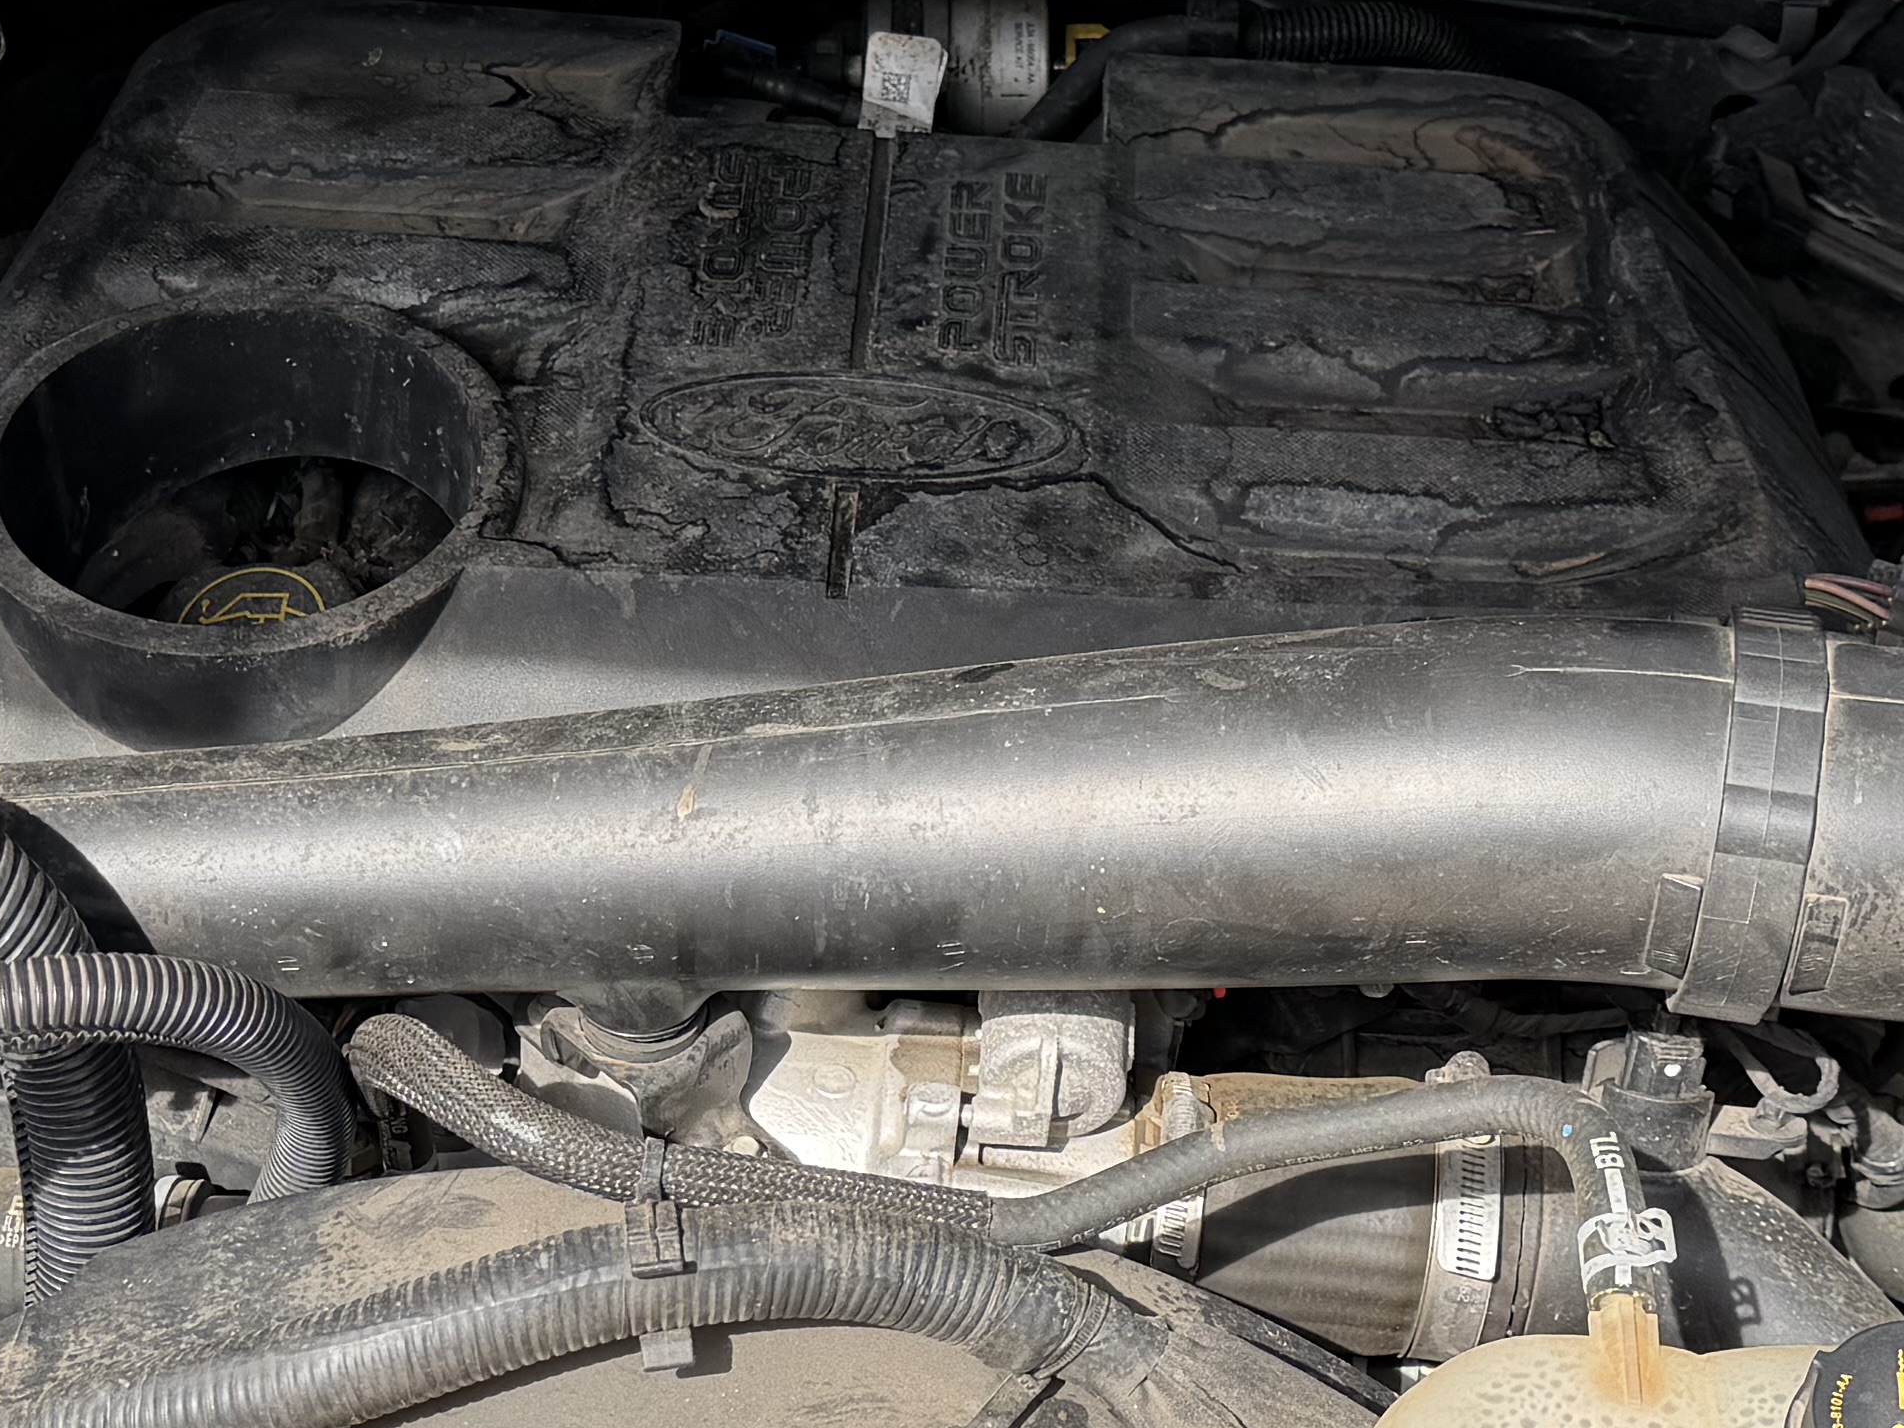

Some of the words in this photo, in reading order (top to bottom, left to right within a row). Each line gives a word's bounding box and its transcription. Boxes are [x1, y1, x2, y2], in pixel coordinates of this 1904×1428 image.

[693, 144, 757, 348] STROKE
[755, 163, 813, 340] POWER
[937, 180, 994, 352] POWER
[994, 172, 1048, 370] STROKE
[1589, 1131, 1626, 1170] BTL
